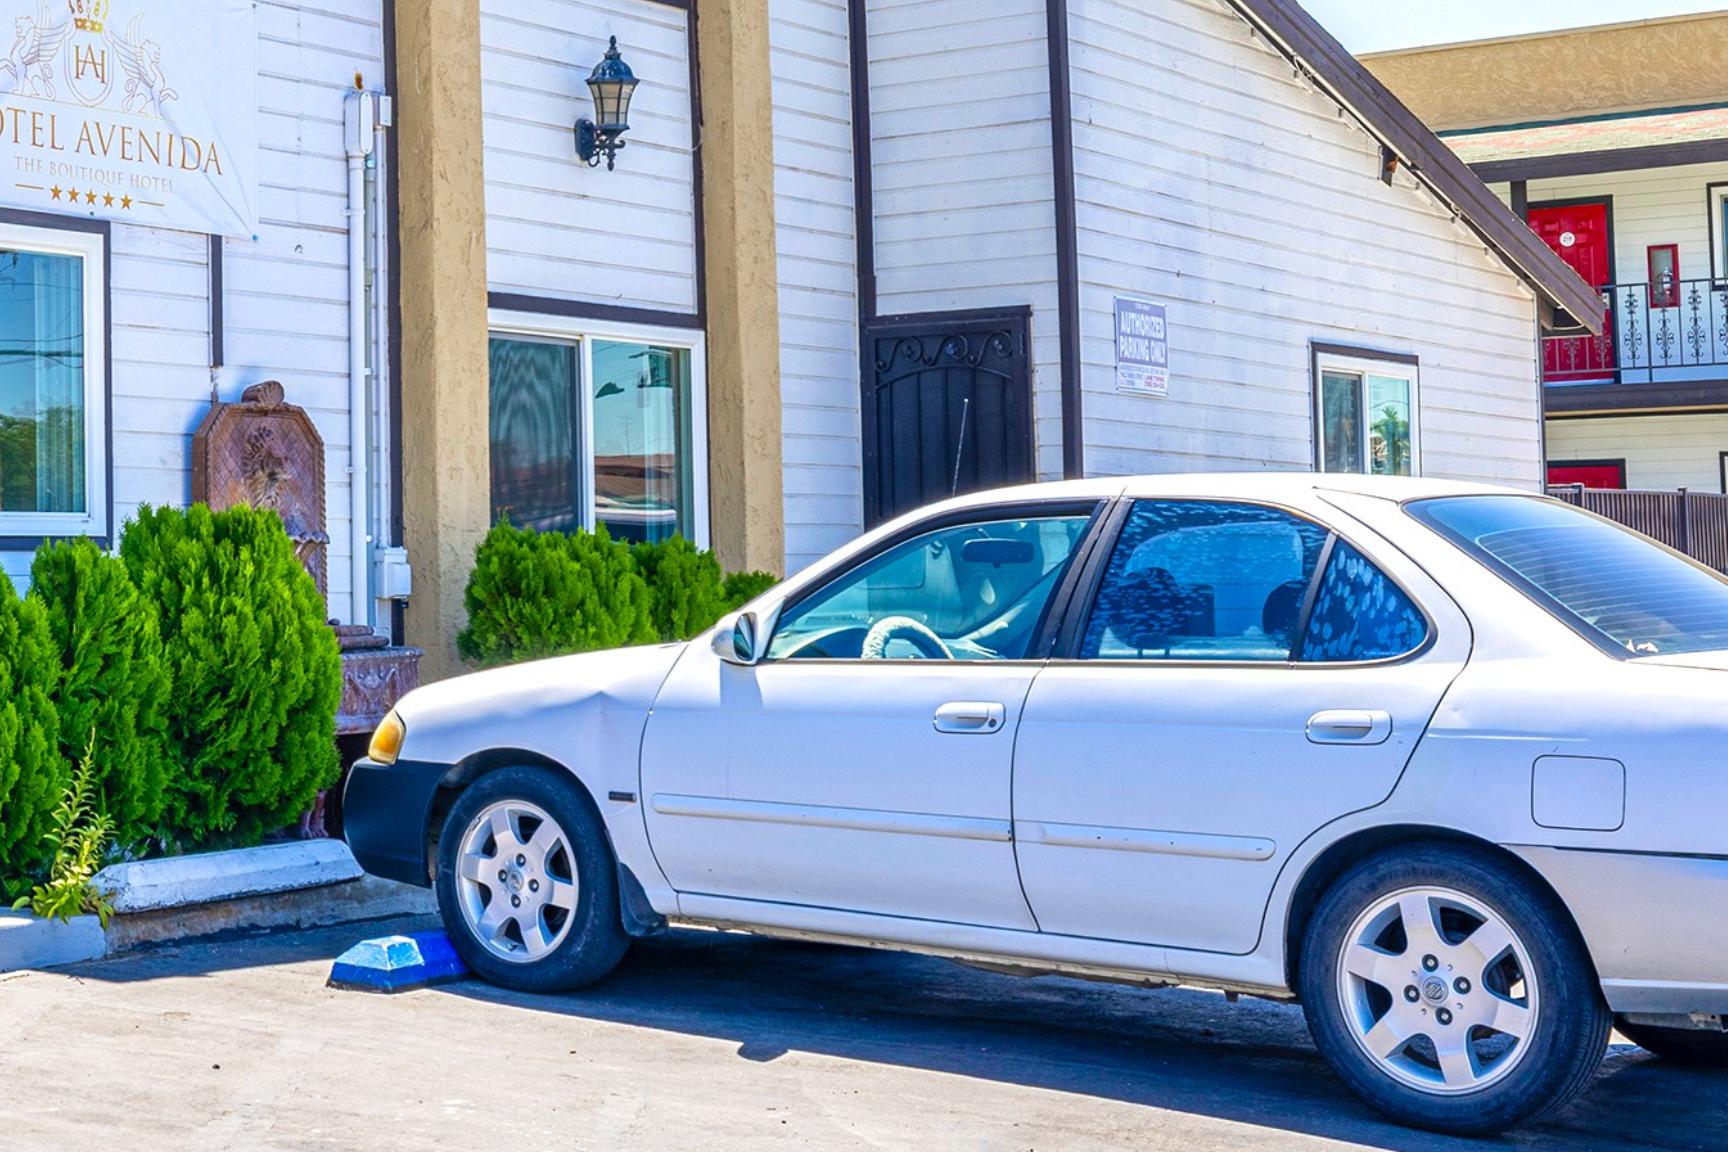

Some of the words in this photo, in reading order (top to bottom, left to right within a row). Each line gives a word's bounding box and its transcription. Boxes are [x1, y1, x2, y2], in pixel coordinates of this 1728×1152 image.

[75, 120, 224, 176] AVENIDA
[13, 155, 43, 175] THE
[50, 161, 124, 188] BOUTIQUE
[130, 173, 176, 194] HOTEL
